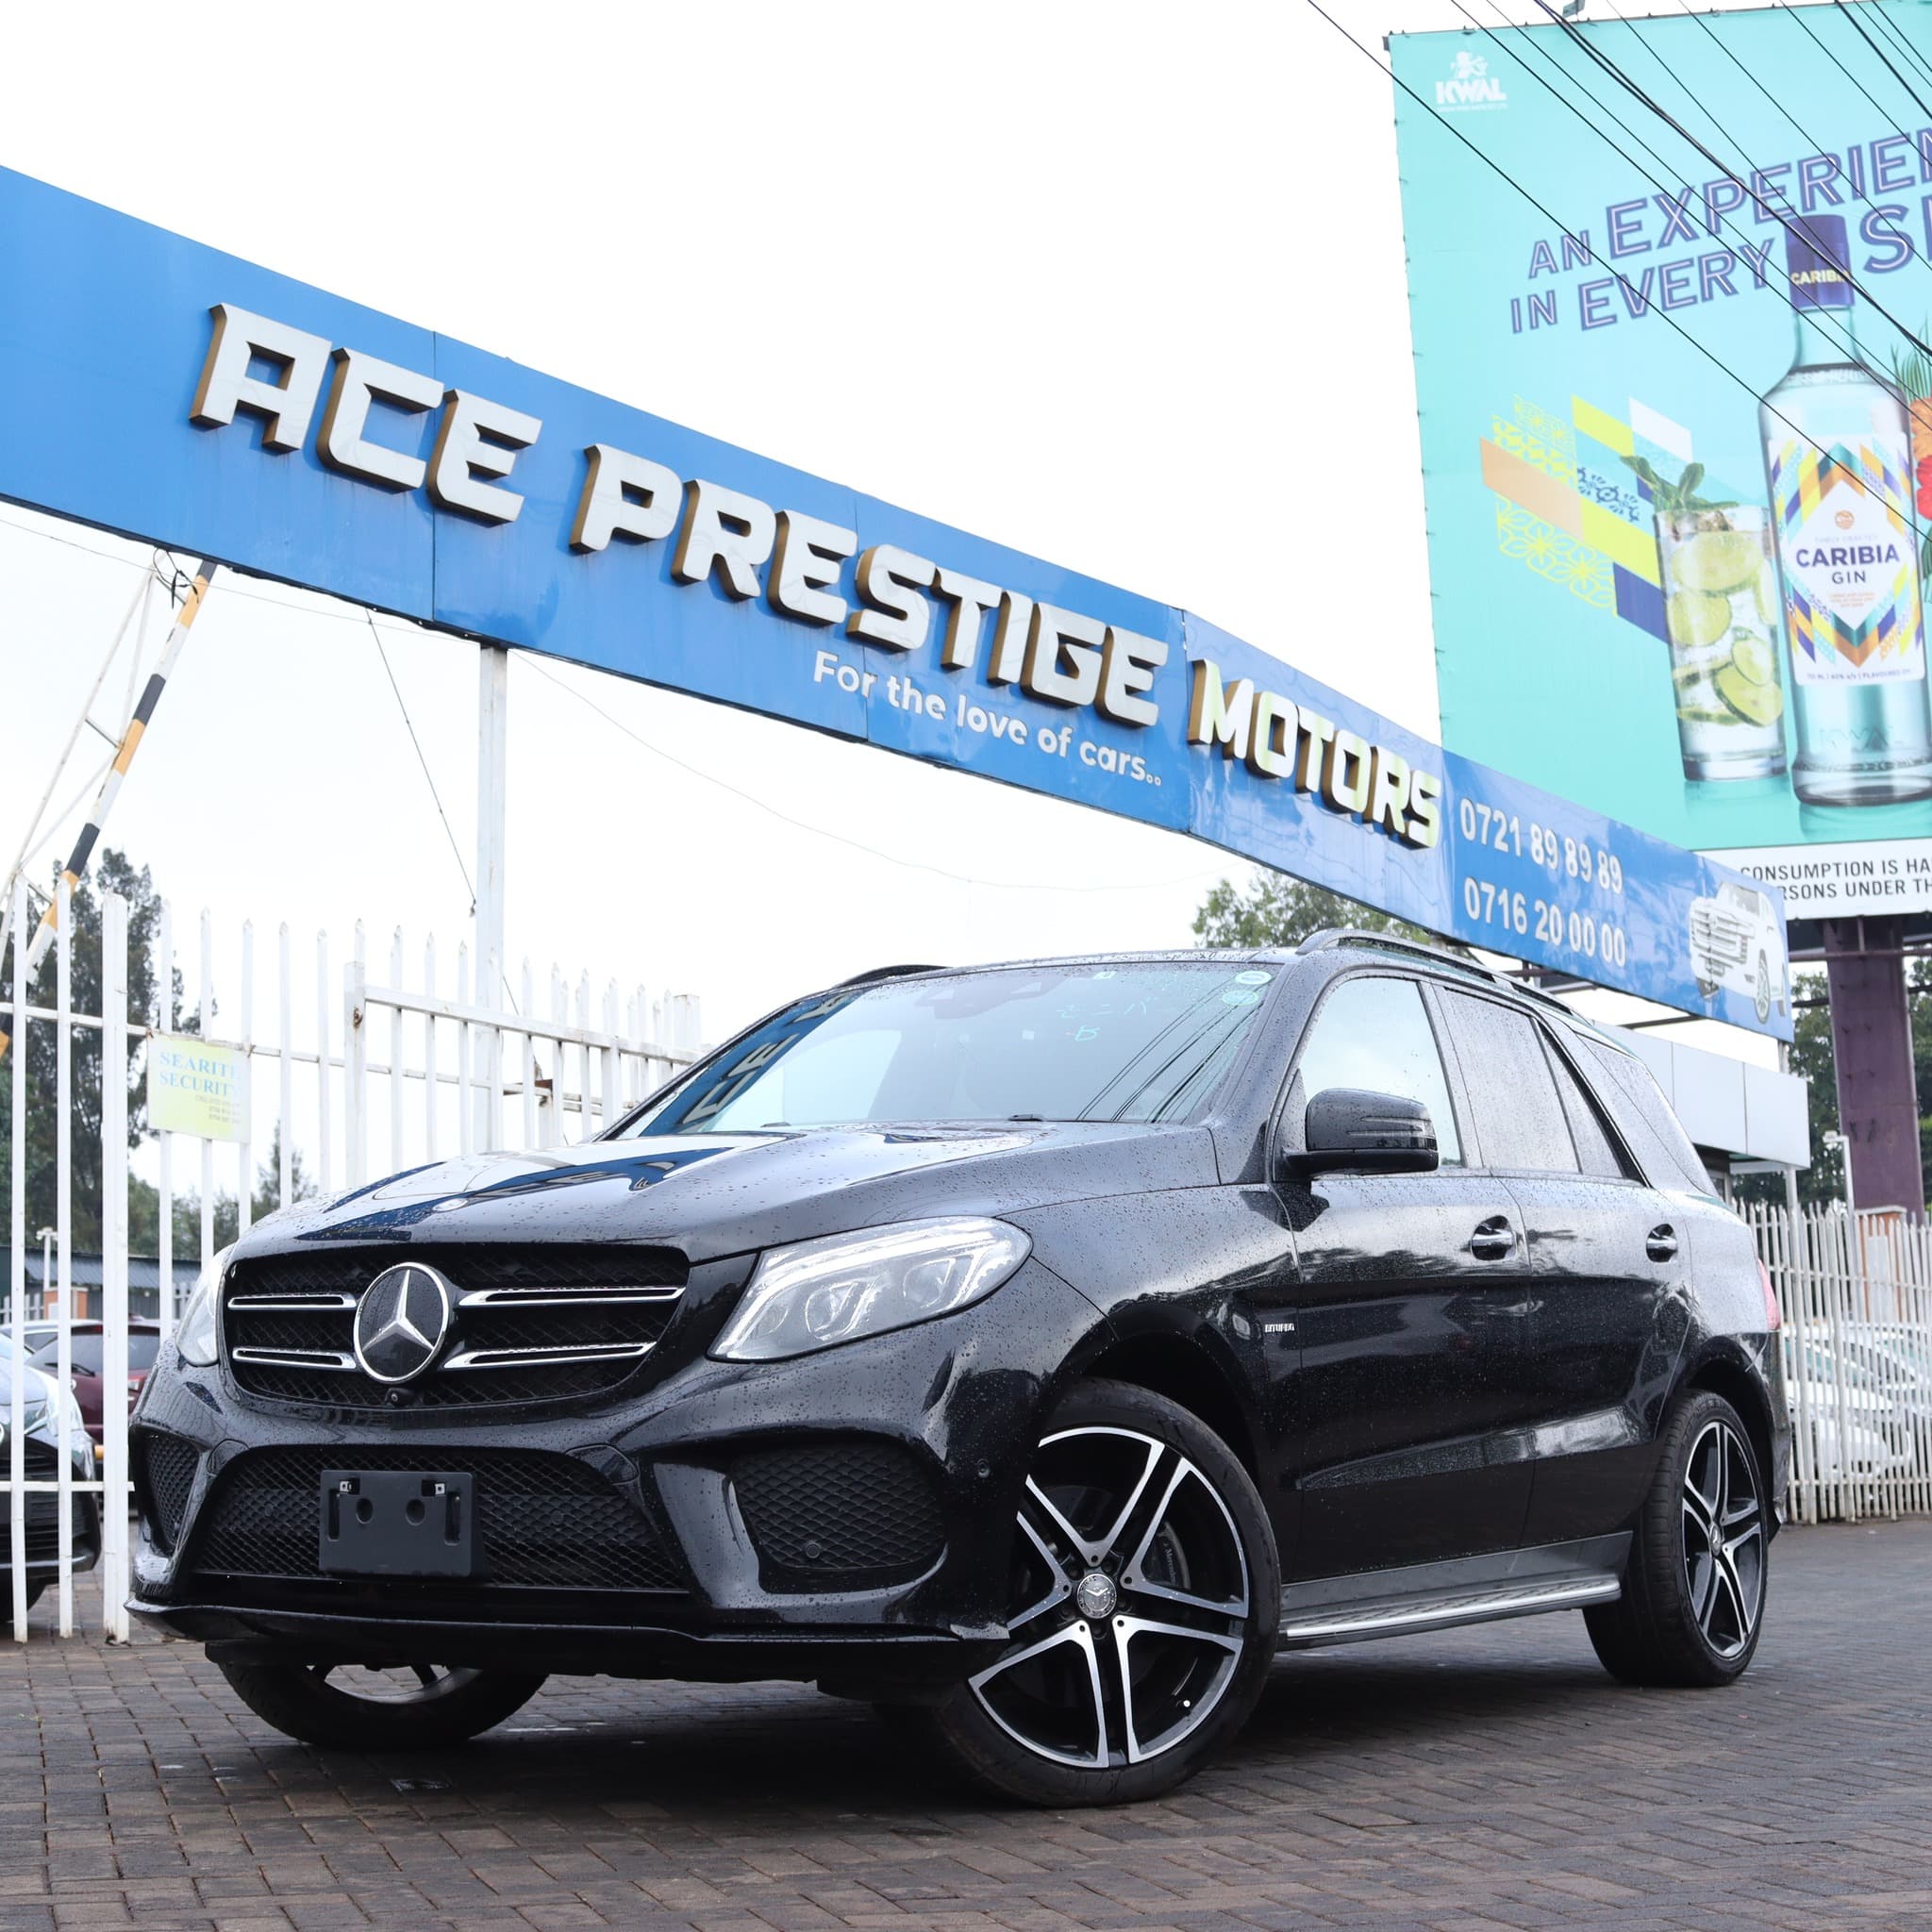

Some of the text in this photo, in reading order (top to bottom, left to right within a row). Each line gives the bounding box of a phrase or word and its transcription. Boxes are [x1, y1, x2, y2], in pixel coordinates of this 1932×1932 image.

[1436, 77, 1507, 104] KWAL
[1509, 194, 1932, 334] IN EVERY S
[1528, 229, 1591, 279] AN
[1790, 268, 1852, 285] CARIB
[1796, 544, 1900, 568] CARIBIA
[191, 303, 1442, 848] ACE PRESTIGE MOTORS
[1832, 571, 1866, 584] GIN
[813, 649, 877, 698] For
[887, 675, 946, 720] the
[958, 694, 1028, 745] love
[1039, 726, 1074, 758] of
[1460, 798, 1623, 895] 0721 89 89 89
[1882, 859, 1898, 874] IS
[1845, 879, 1906, 897] UNDER
[1464, 877, 1625, 968] 0716 20 00 00
[159, 1072, 242, 1100] SECURITY
